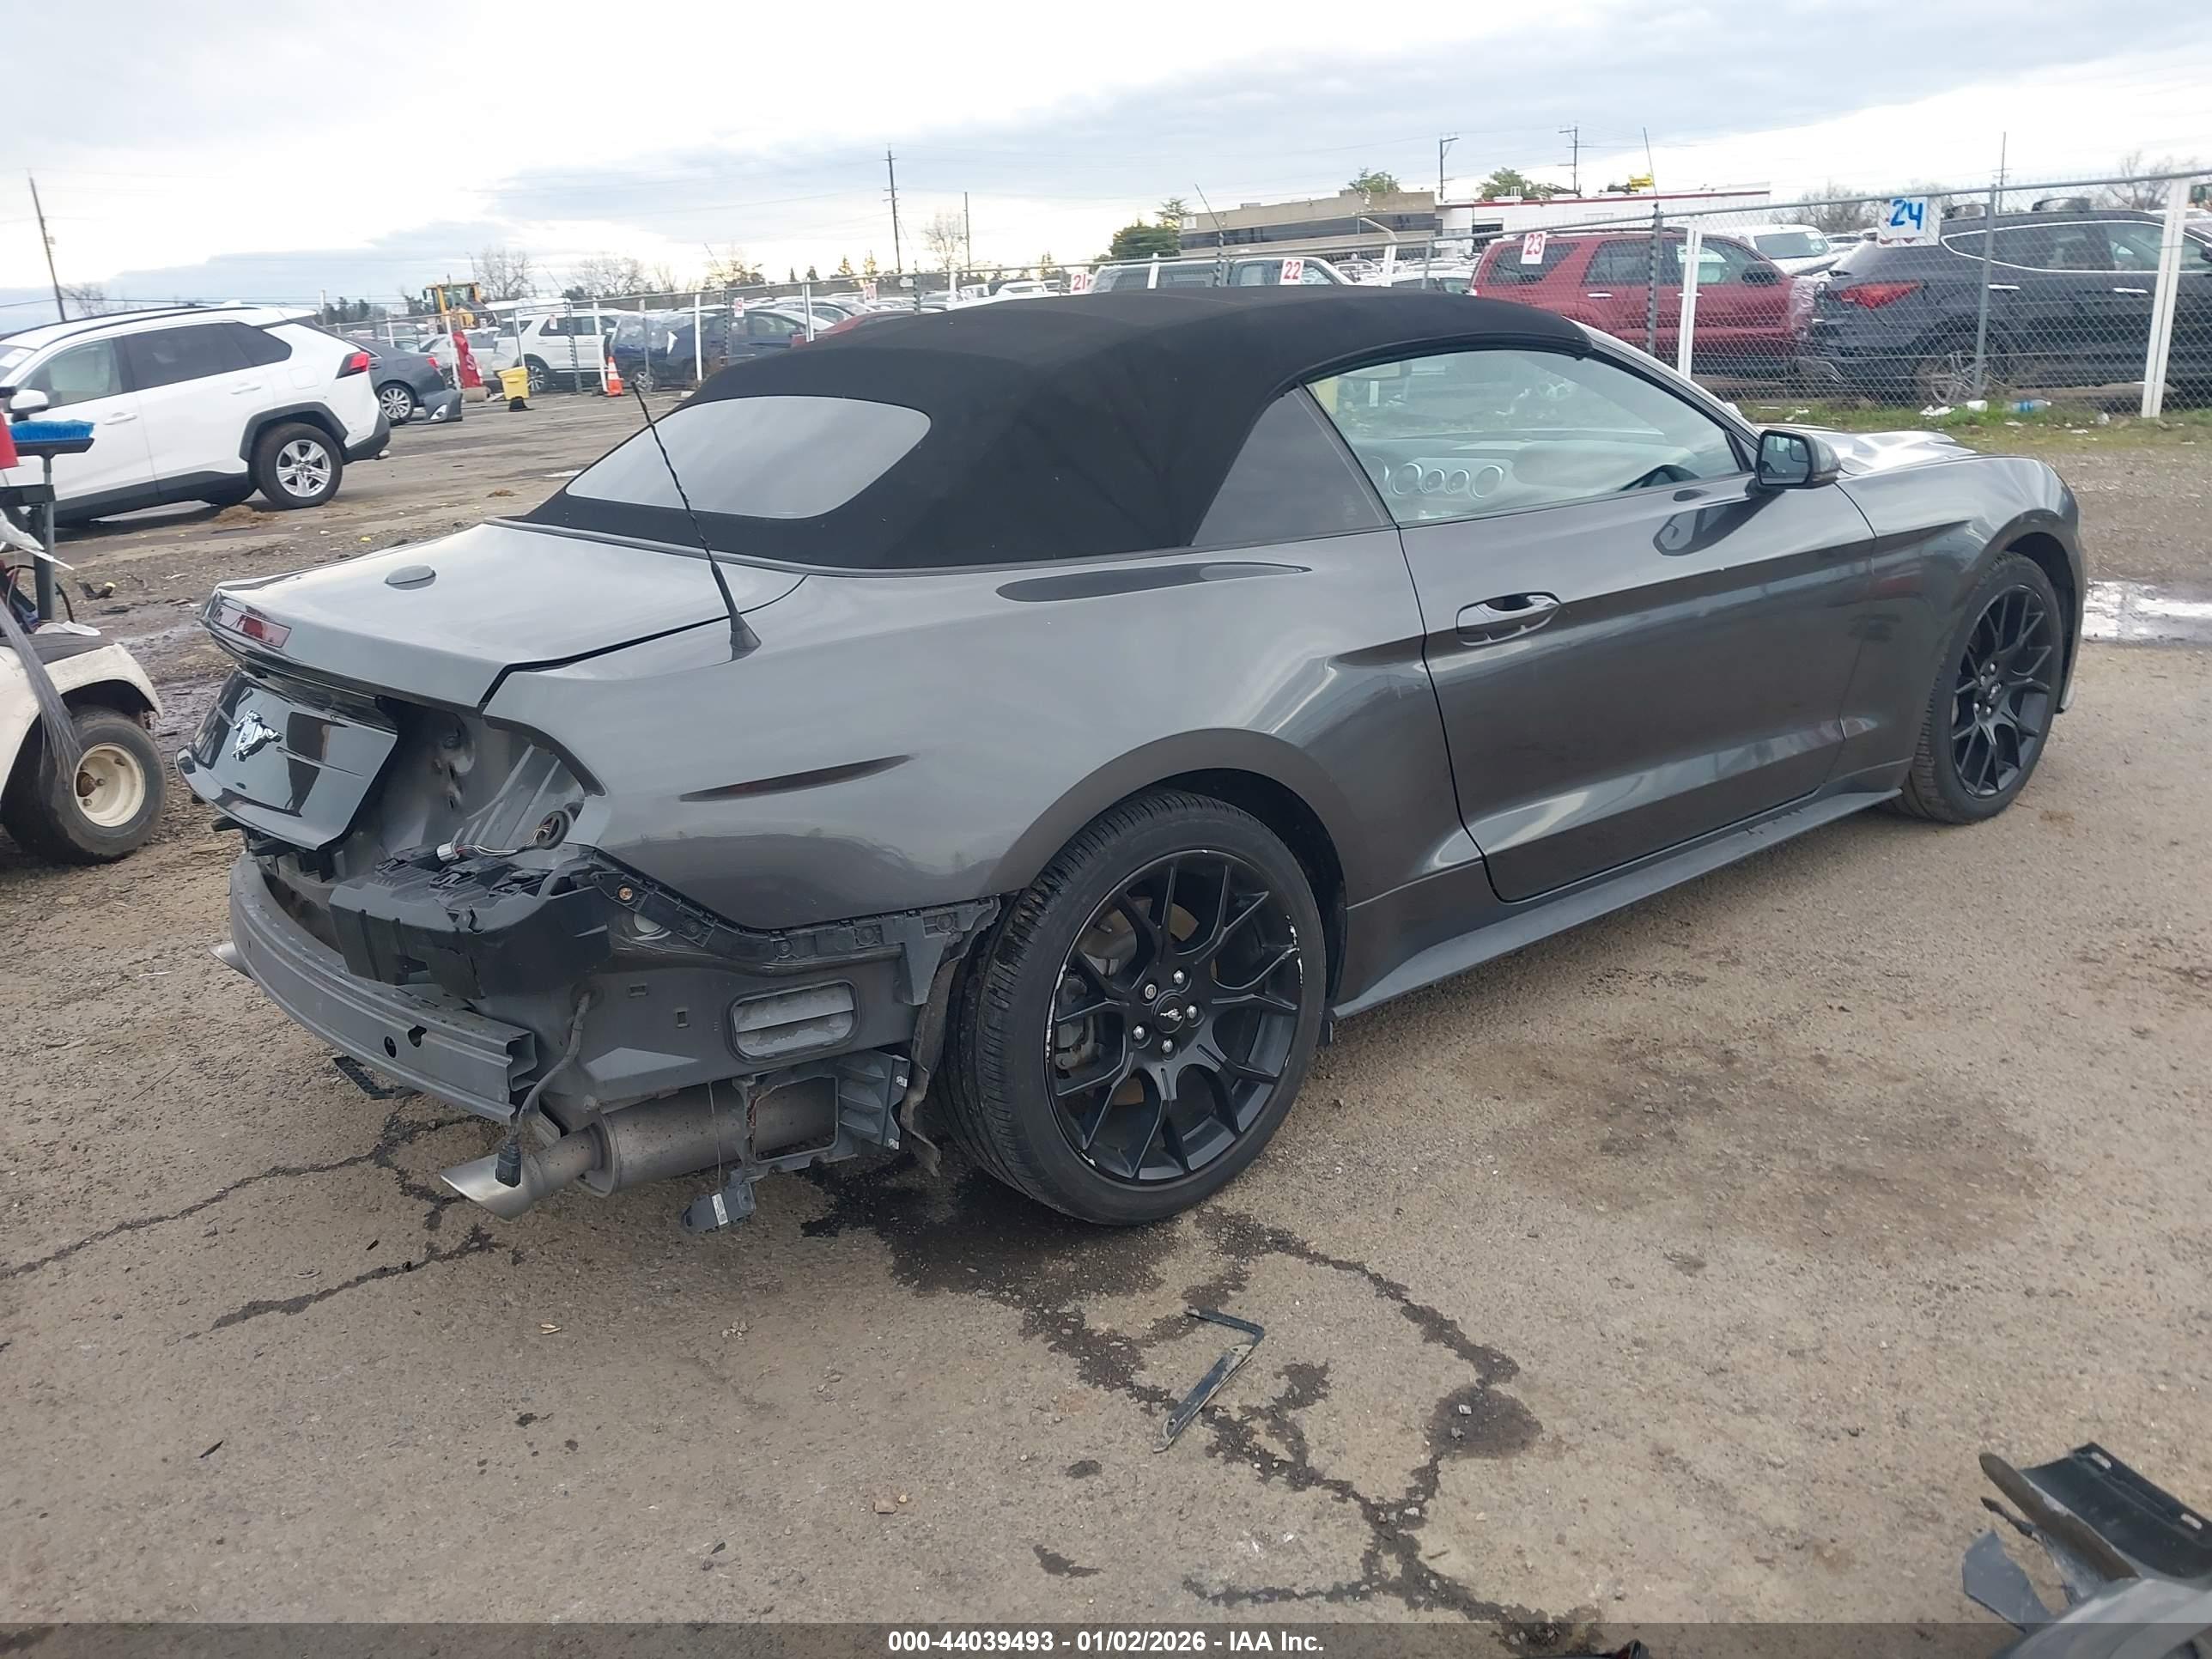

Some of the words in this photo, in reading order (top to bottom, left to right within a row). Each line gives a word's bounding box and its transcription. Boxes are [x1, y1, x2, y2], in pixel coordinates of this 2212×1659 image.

[1891, 199, 1923, 230] 24
[1525, 233, 1543, 255] 23
[1284, 261, 1301, 280] 22
[1073, 274, 1086, 290] 21
